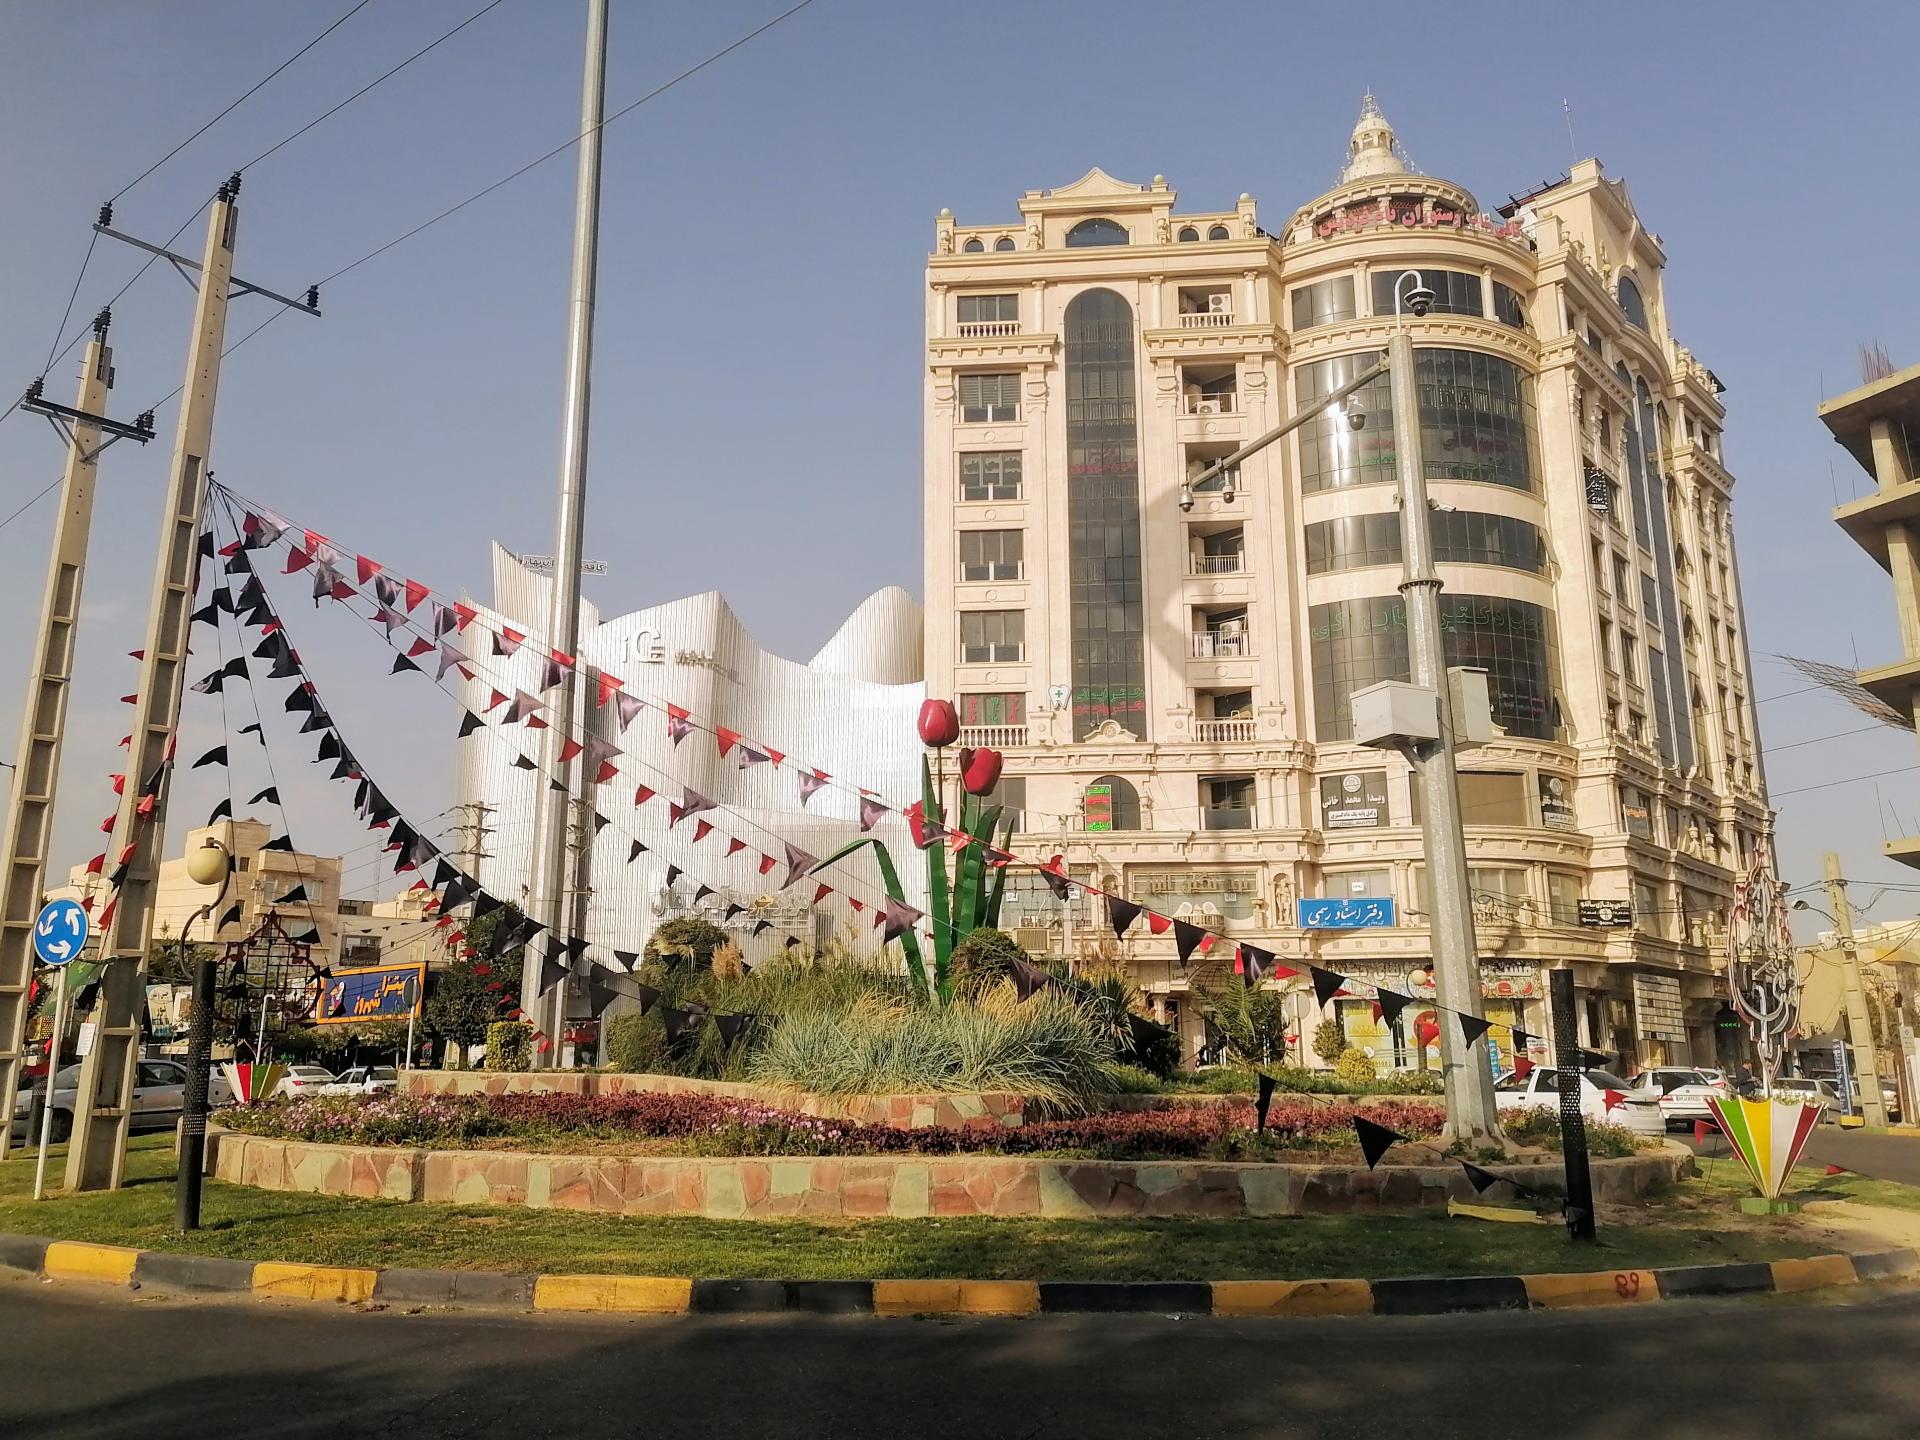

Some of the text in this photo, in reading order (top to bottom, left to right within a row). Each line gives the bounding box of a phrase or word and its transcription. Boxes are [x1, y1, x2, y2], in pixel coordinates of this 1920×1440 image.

[1307, 903, 1384, 925] دفتر اسناد رسمی
[382, 975, 405, 998] یتزا
